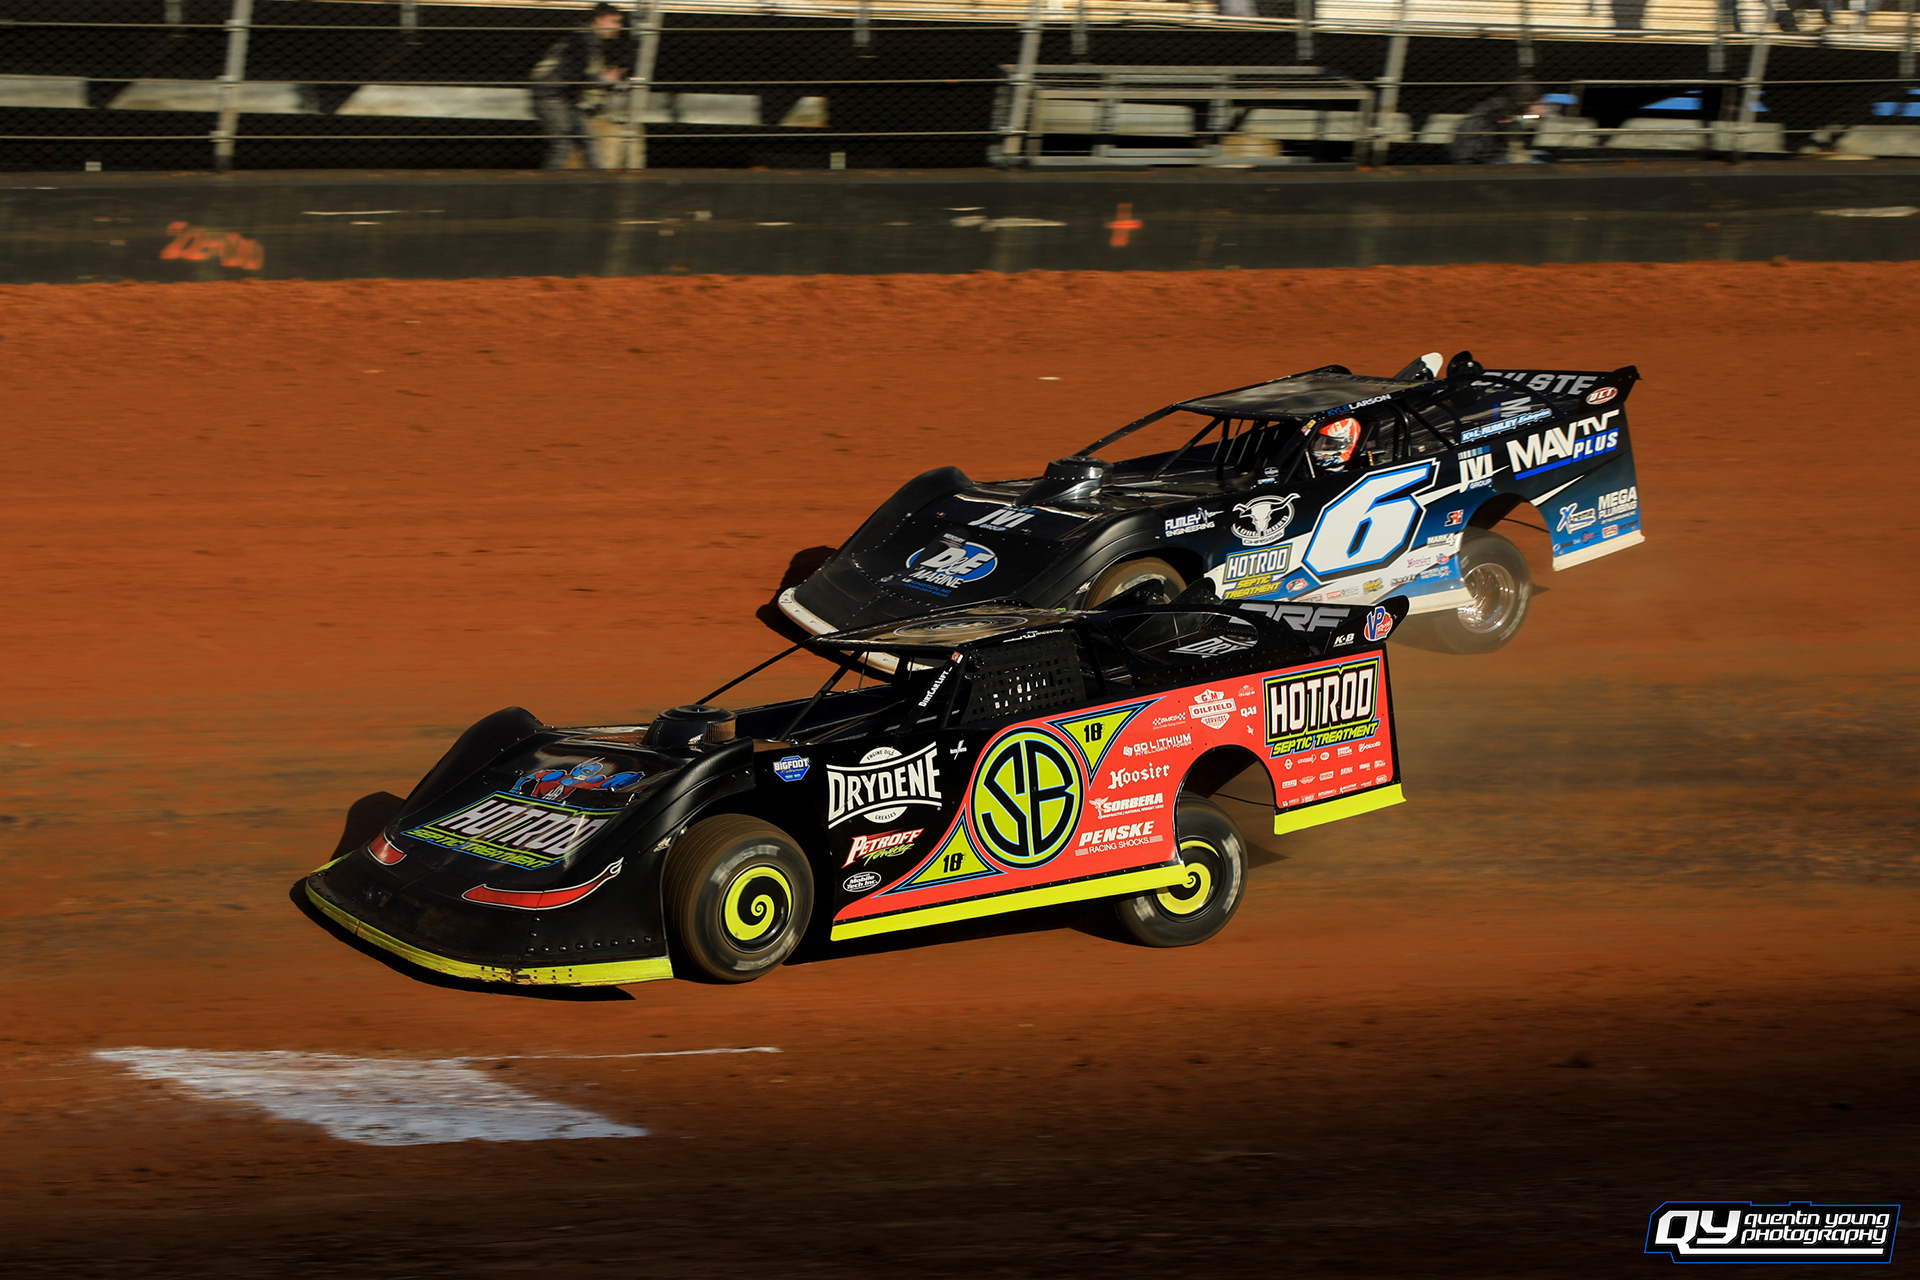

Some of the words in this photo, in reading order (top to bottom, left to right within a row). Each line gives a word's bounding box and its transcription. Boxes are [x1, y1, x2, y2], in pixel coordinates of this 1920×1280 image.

[1348, 393, 1392, 410] LARSON
[1573, 430, 1620, 460] PLUS
[1598, 486, 1638, 511] MEGA
[1598, 500, 1638, 520] PLUMBING
[1165, 521, 1215, 538] ENGINEERING
[1301, 460, 1440, 583] 6
[920, 547, 996, 577] D&E
[1227, 549, 1288, 579] HOTROD
[908, 568, 964, 589] MARINE
[1236, 576, 1271, 589] SEPTIC
[1224, 582, 1282, 600] TREATMENT
[1193, 702, 1232, 715] OILFIELD
[1240, 706, 1257, 717] QA1
[1270, 668, 1374, 735] HOTROD
[1205, 715, 1227, 724] SERVICES
[1083, 722, 1102, 743] 18
[1133, 742, 1148, 752] GO
[1149, 733, 1192, 749] LITHIUM
[1273, 736, 1312, 755] SEPTIC
[1315, 722, 1378, 745] TREATMENT
[773, 758, 809, 771] BIGFOOT
[867, 750, 883, 760] ENGINE
[827, 748, 942, 822] DRYDENE
[1107, 762, 1170, 789] Hoosier
[1103, 792, 1164, 813] SORBERA
[875, 811, 897, 820] GREASES
[438, 799, 609, 855] HOTROD
[1079, 820, 1155, 847] PENSKE
[407, 828, 464, 848] SEPTIC
[462, 843, 551, 869] TREATMENT
[842, 829, 923, 868] PETROFF
[1088, 842, 1117, 854] RACING
[1118, 836, 1149, 849] SHOCKS
[942, 852, 963, 873] 18
